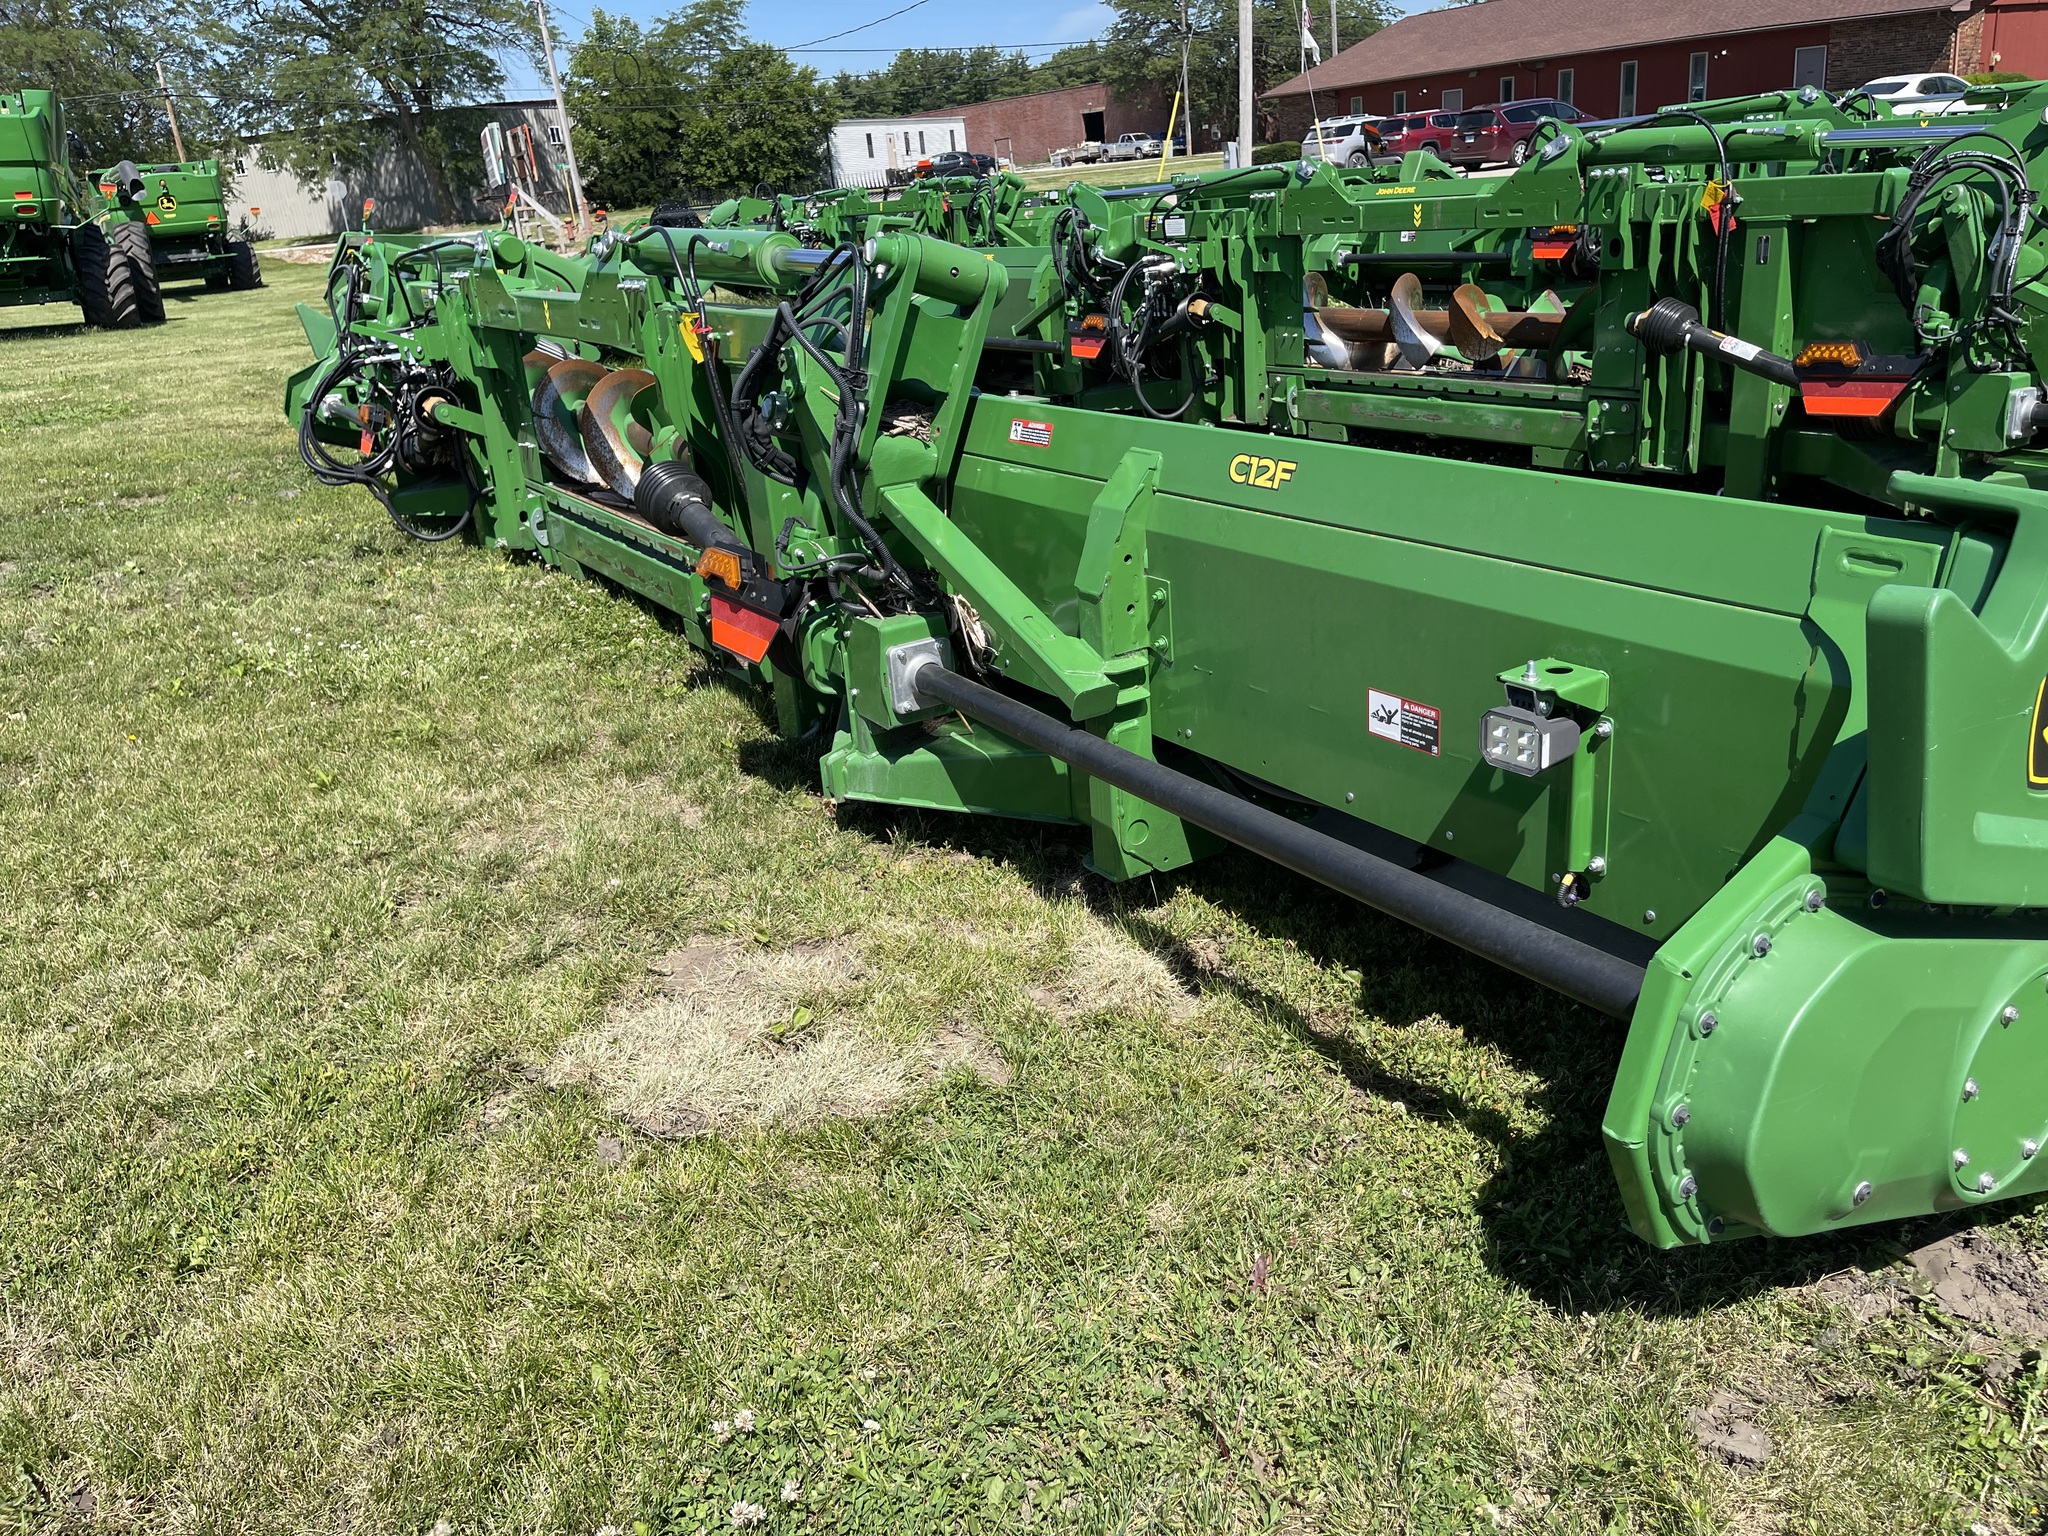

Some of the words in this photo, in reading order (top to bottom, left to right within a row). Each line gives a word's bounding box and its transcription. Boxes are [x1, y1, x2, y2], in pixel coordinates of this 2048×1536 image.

[1376, 188, 1394, 196] JOHN
[1394, 186, 1416, 195] DEERE
[1229, 453, 1298, 491] C12F
[1410, 704, 1436, 718] DANGER
